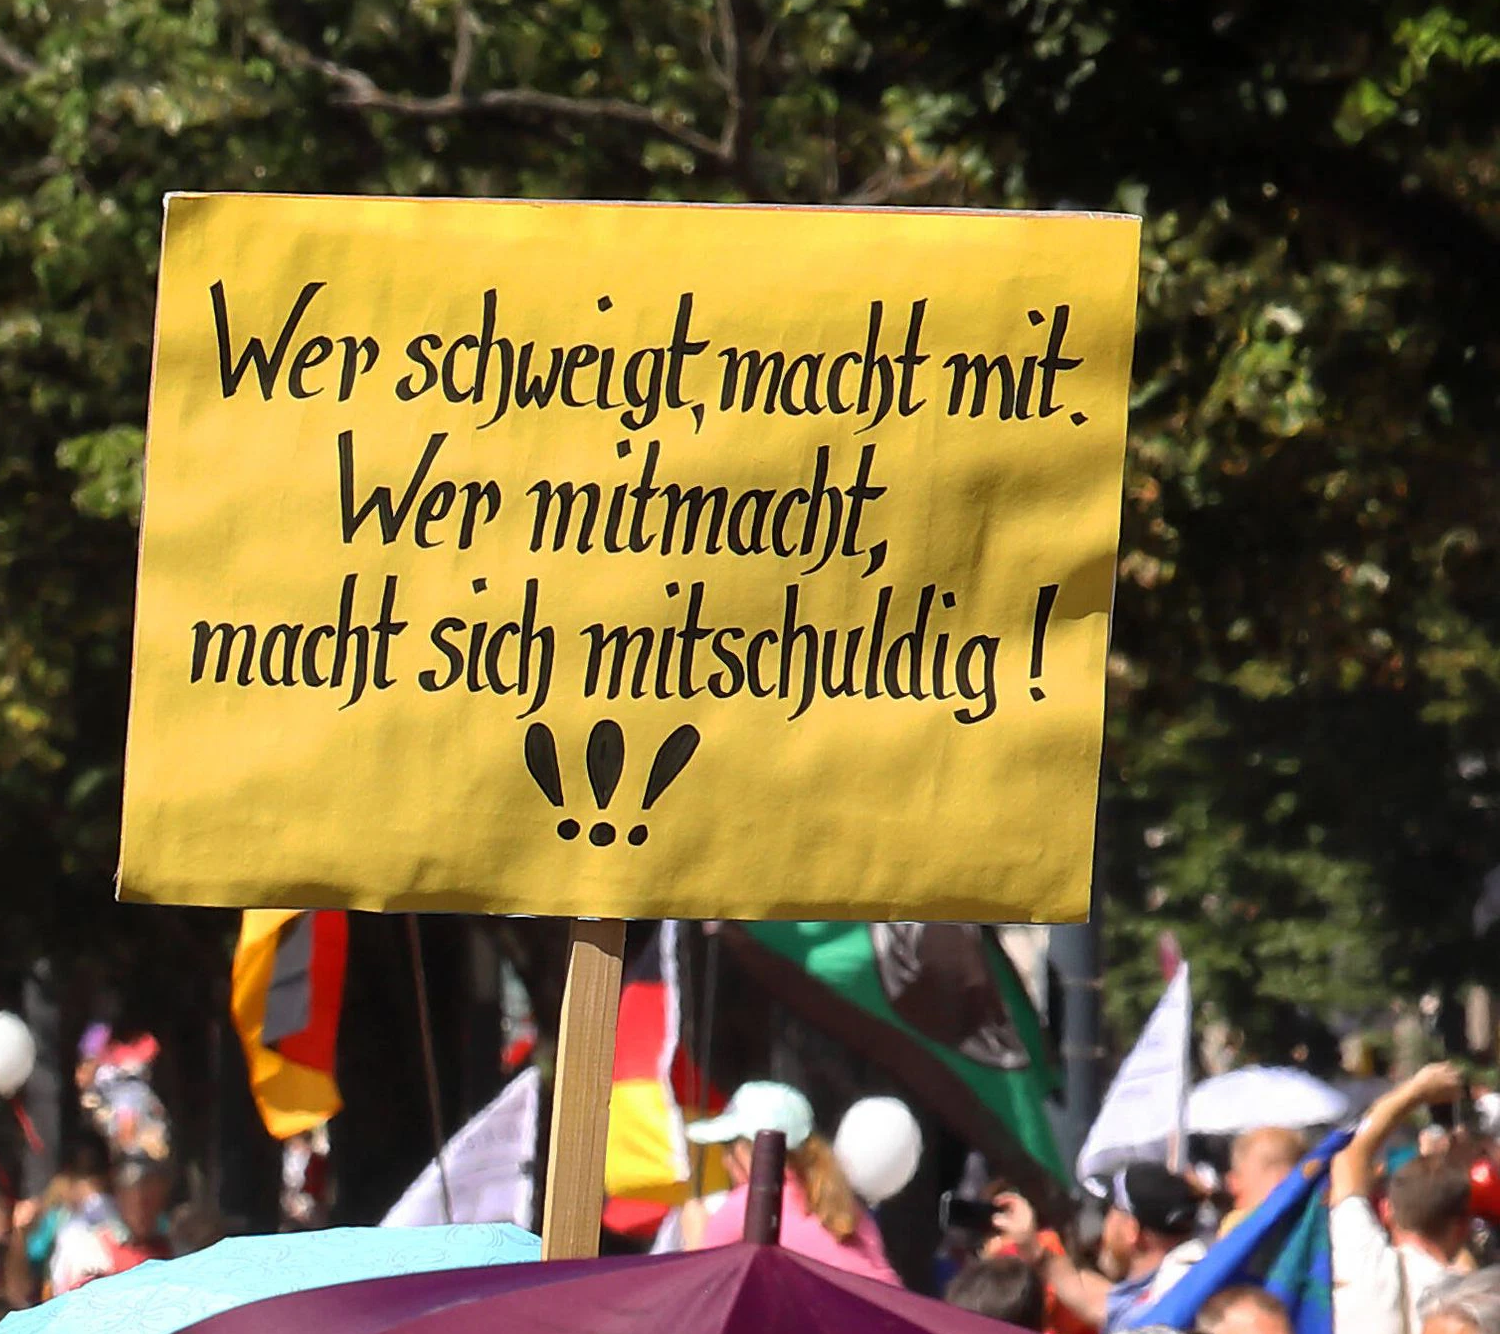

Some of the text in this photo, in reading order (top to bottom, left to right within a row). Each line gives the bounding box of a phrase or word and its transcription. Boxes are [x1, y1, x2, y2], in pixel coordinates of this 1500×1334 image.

[208, 278, 381, 403] Wer
[716, 297, 932, 436] macht
[941, 304, 1090, 428] mit.
[337, 428, 889, 580] Wer mitmacht,
[189, 572, 410, 712] macht
[417, 576, 556, 721] sich
[578, 578, 1002, 726] mitschuldig
